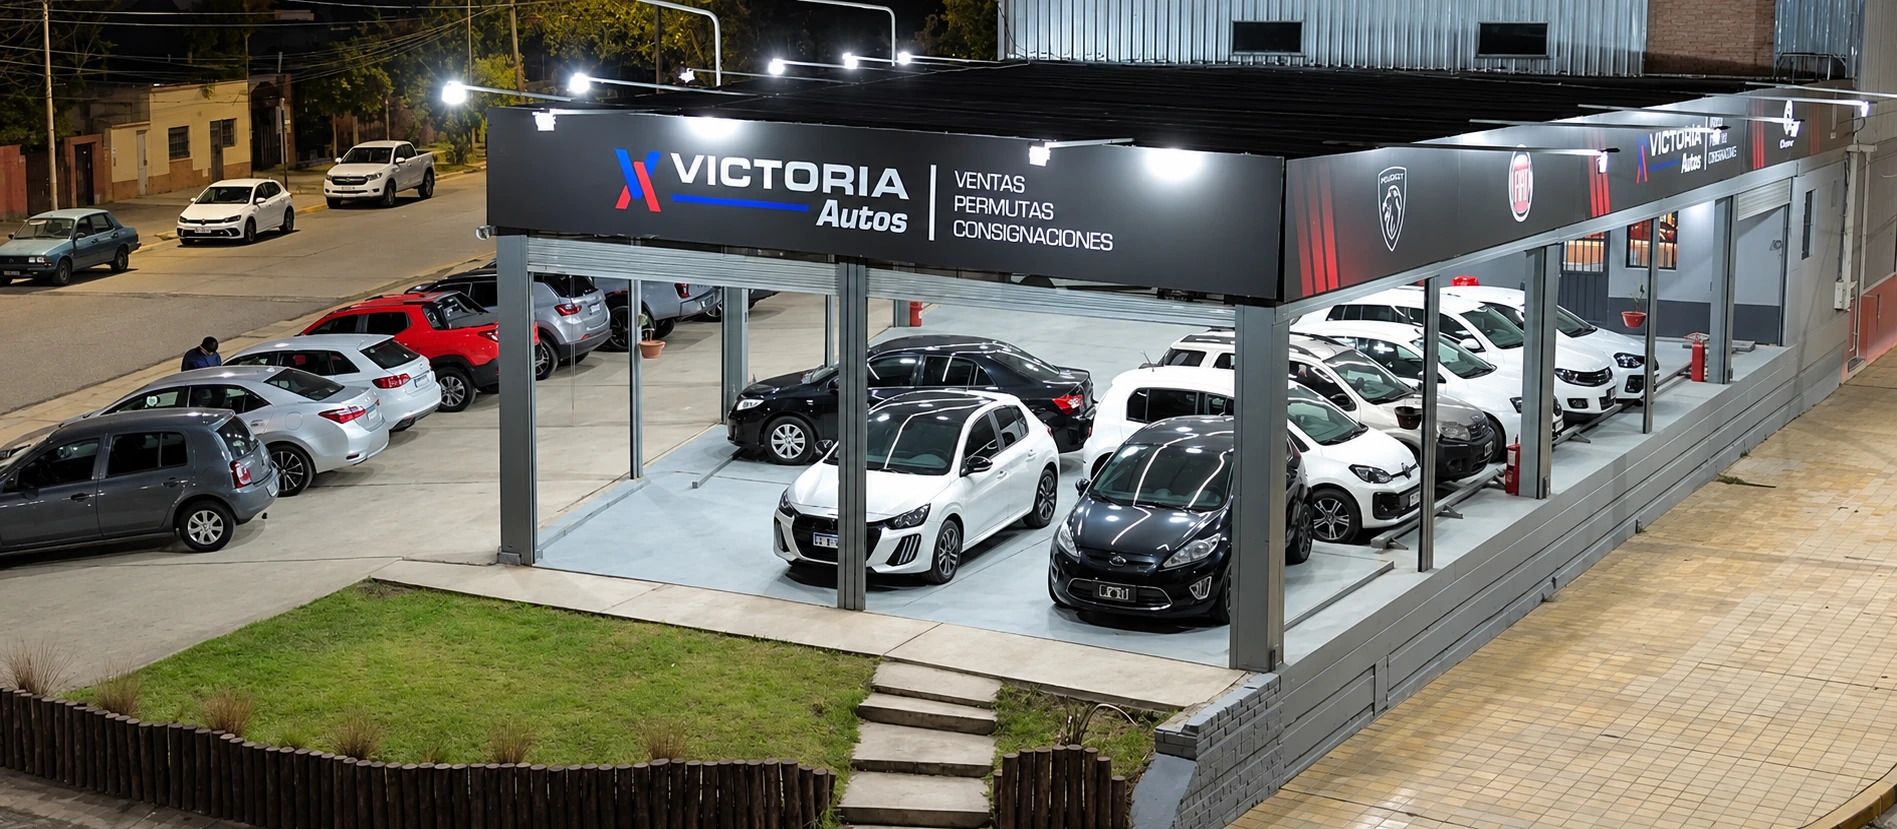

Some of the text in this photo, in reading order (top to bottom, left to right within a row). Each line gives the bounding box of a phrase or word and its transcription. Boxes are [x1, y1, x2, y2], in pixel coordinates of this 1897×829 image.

[1650, 124, 1702, 156] VICTORIA
[670, 152, 910, 200] VICTORIA
[1681, 153, 1702, 173] Autos
[954, 170, 1026, 194] VENTAS
[816, 199, 909, 233] Autos
[954, 195, 1054, 220] PERMUTAS
[953, 220, 1114, 252] CONSIGNACIONES
